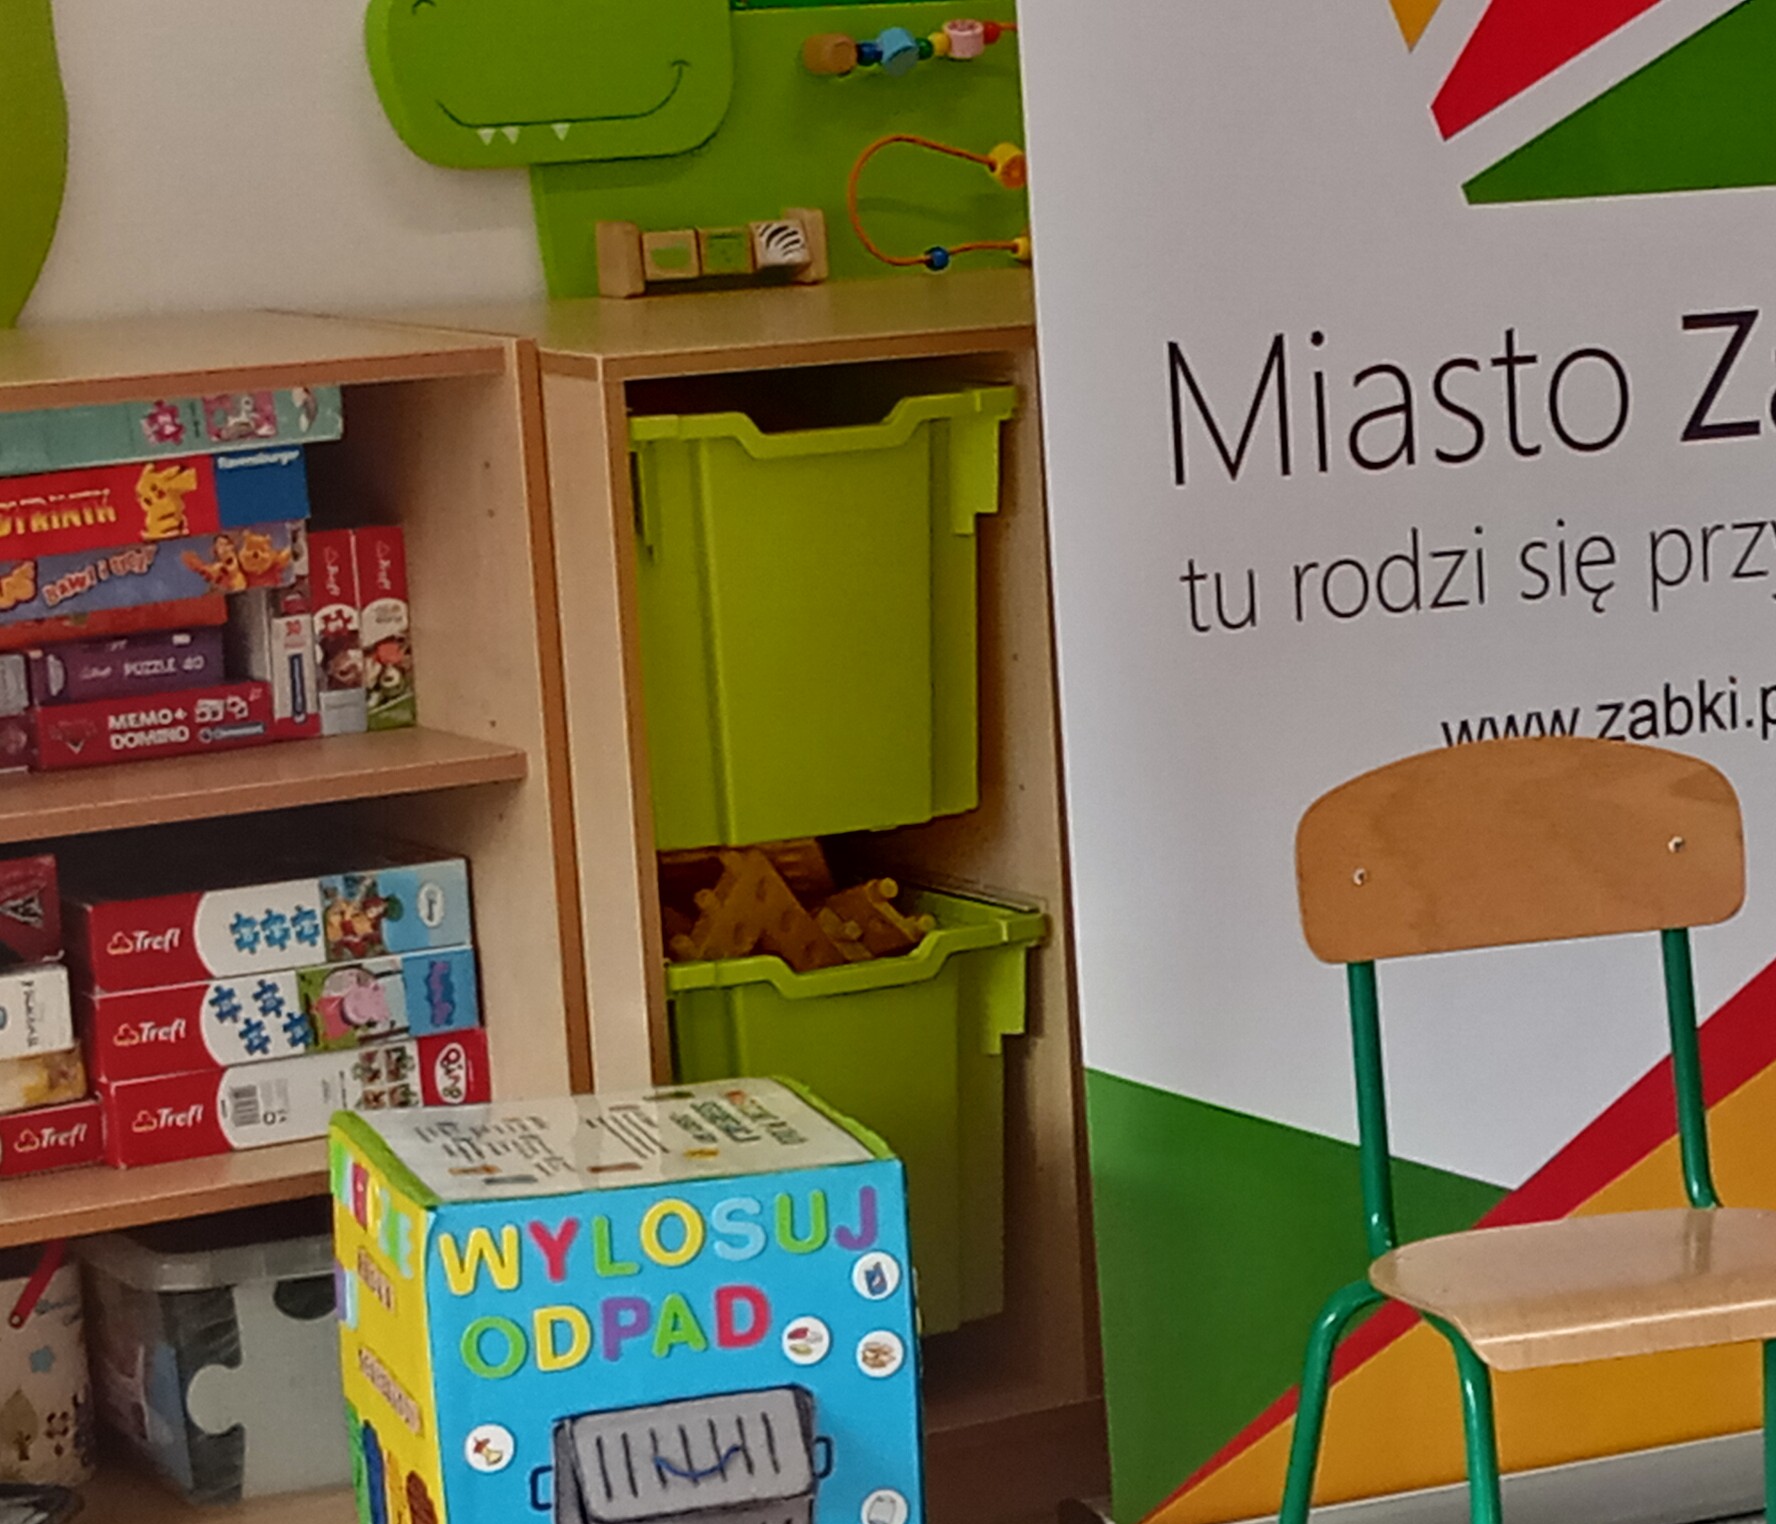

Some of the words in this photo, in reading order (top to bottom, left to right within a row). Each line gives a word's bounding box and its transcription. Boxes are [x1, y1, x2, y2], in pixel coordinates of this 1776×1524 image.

[1165, 327, 1633, 487] Miasto
[217, 449, 300, 470] Ravensburger
[1180, 556, 1258, 634] tu
[1292, 526, 1488, 623] rodzi
[1519, 518, 1618, 614] się
[123, 656, 177, 677] PUZZLE
[110, 726, 190, 750] DOMINO
[132, 927, 182, 953] Trefl
[138, 1018, 187, 1044] Trefl
[157, 1104, 204, 1129] Trefl
[40, 1123, 87, 1151] Trefl
[438, 1185, 879, 1297] WYLOSUJ
[460, 1283, 772, 1380] ODPAD
